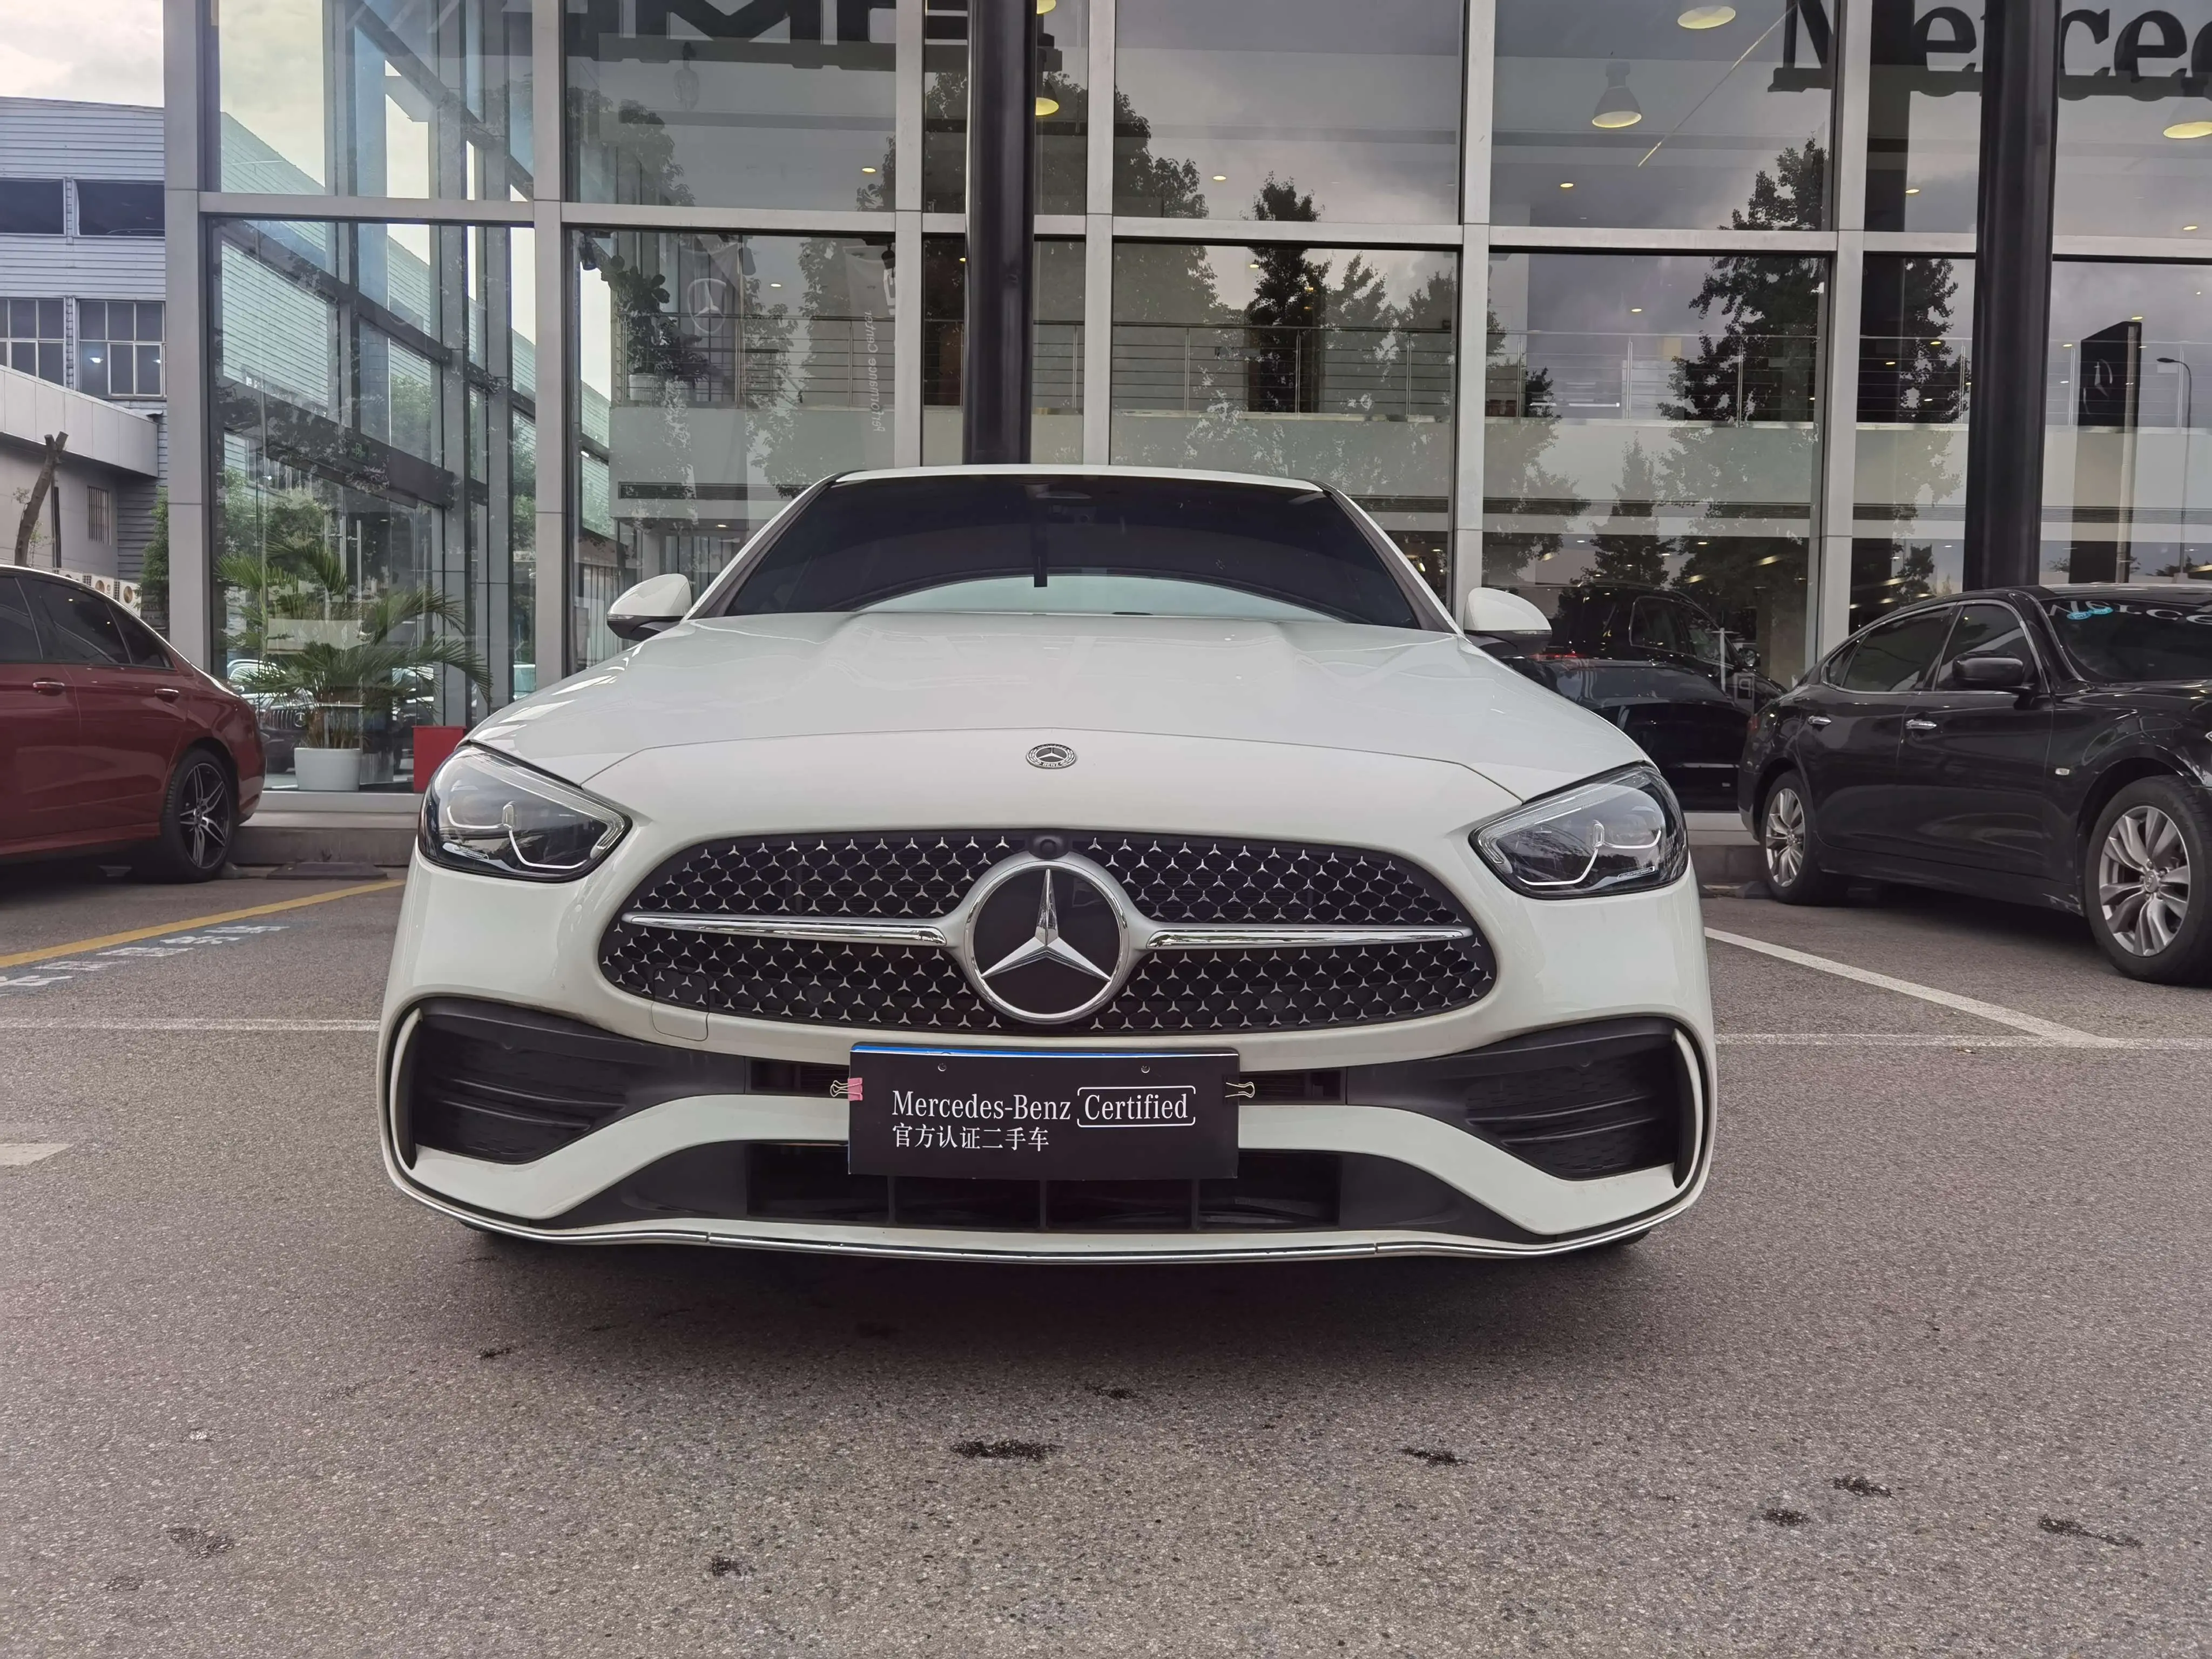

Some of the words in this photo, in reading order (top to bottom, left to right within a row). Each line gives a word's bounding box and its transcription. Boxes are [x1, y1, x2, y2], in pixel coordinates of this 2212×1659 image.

[892, 1090, 1071, 1120] Mercedes-Benz
[1084, 1094, 1188, 1120] Certified
[892, 1122, 1049, 1152] 官方认证二手车
